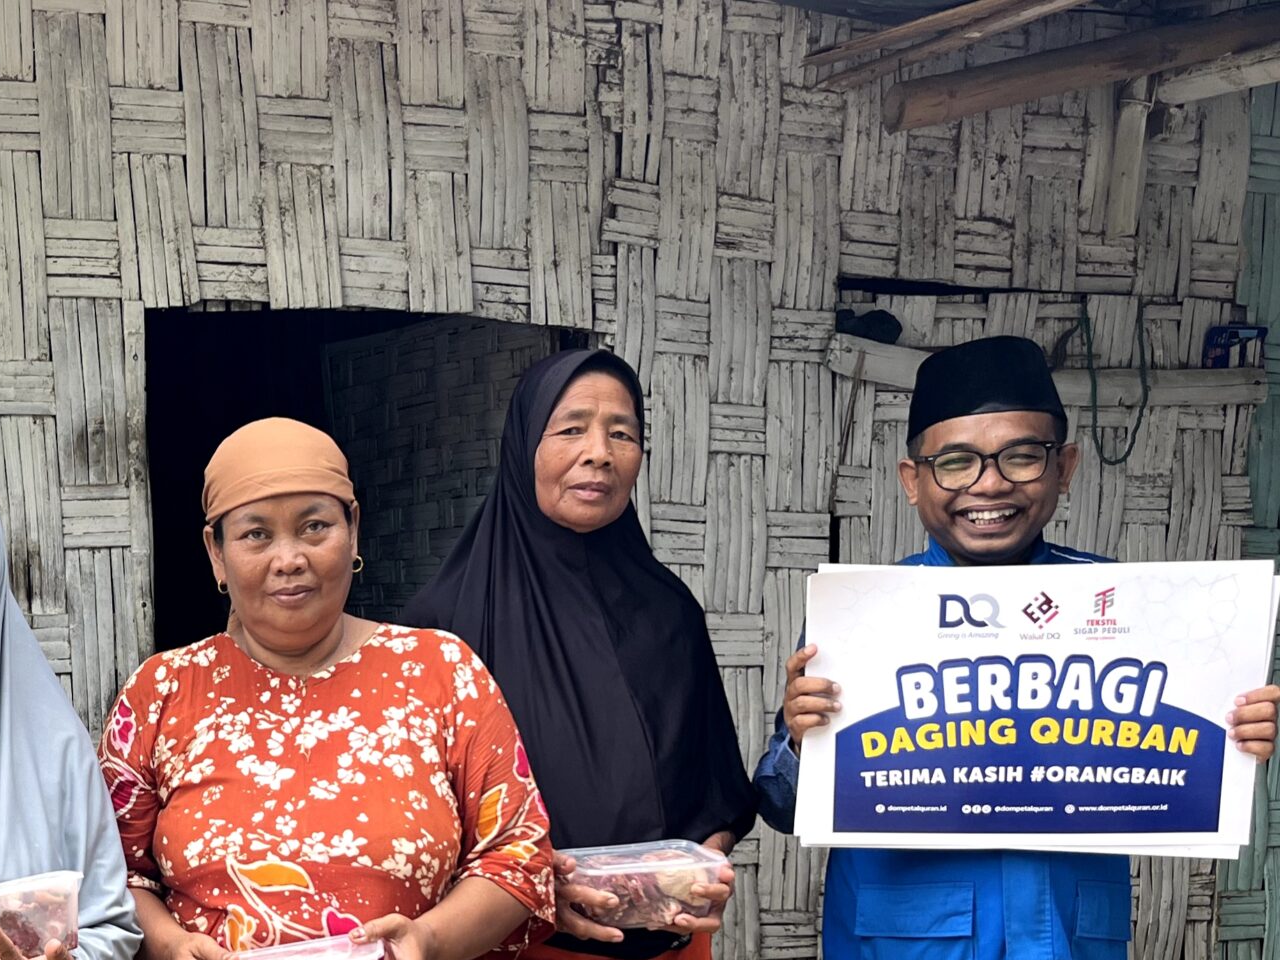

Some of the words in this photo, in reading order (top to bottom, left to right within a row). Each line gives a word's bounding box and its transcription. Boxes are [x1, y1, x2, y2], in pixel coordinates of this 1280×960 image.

[1046, 632, 1061, 640] DQ
[1073, 627, 1099, 635] SIGAP
[900, 661, 1164, 720] BERBAGI
[860, 716, 1017, 758] DAGING
[1030, 717, 1199, 755] QURBAN
[861, 768, 946, 788] TERIMA
[953, 767, 1023, 783] KASIH
[1030, 766, 1187, 786] #ORANGBAIK
